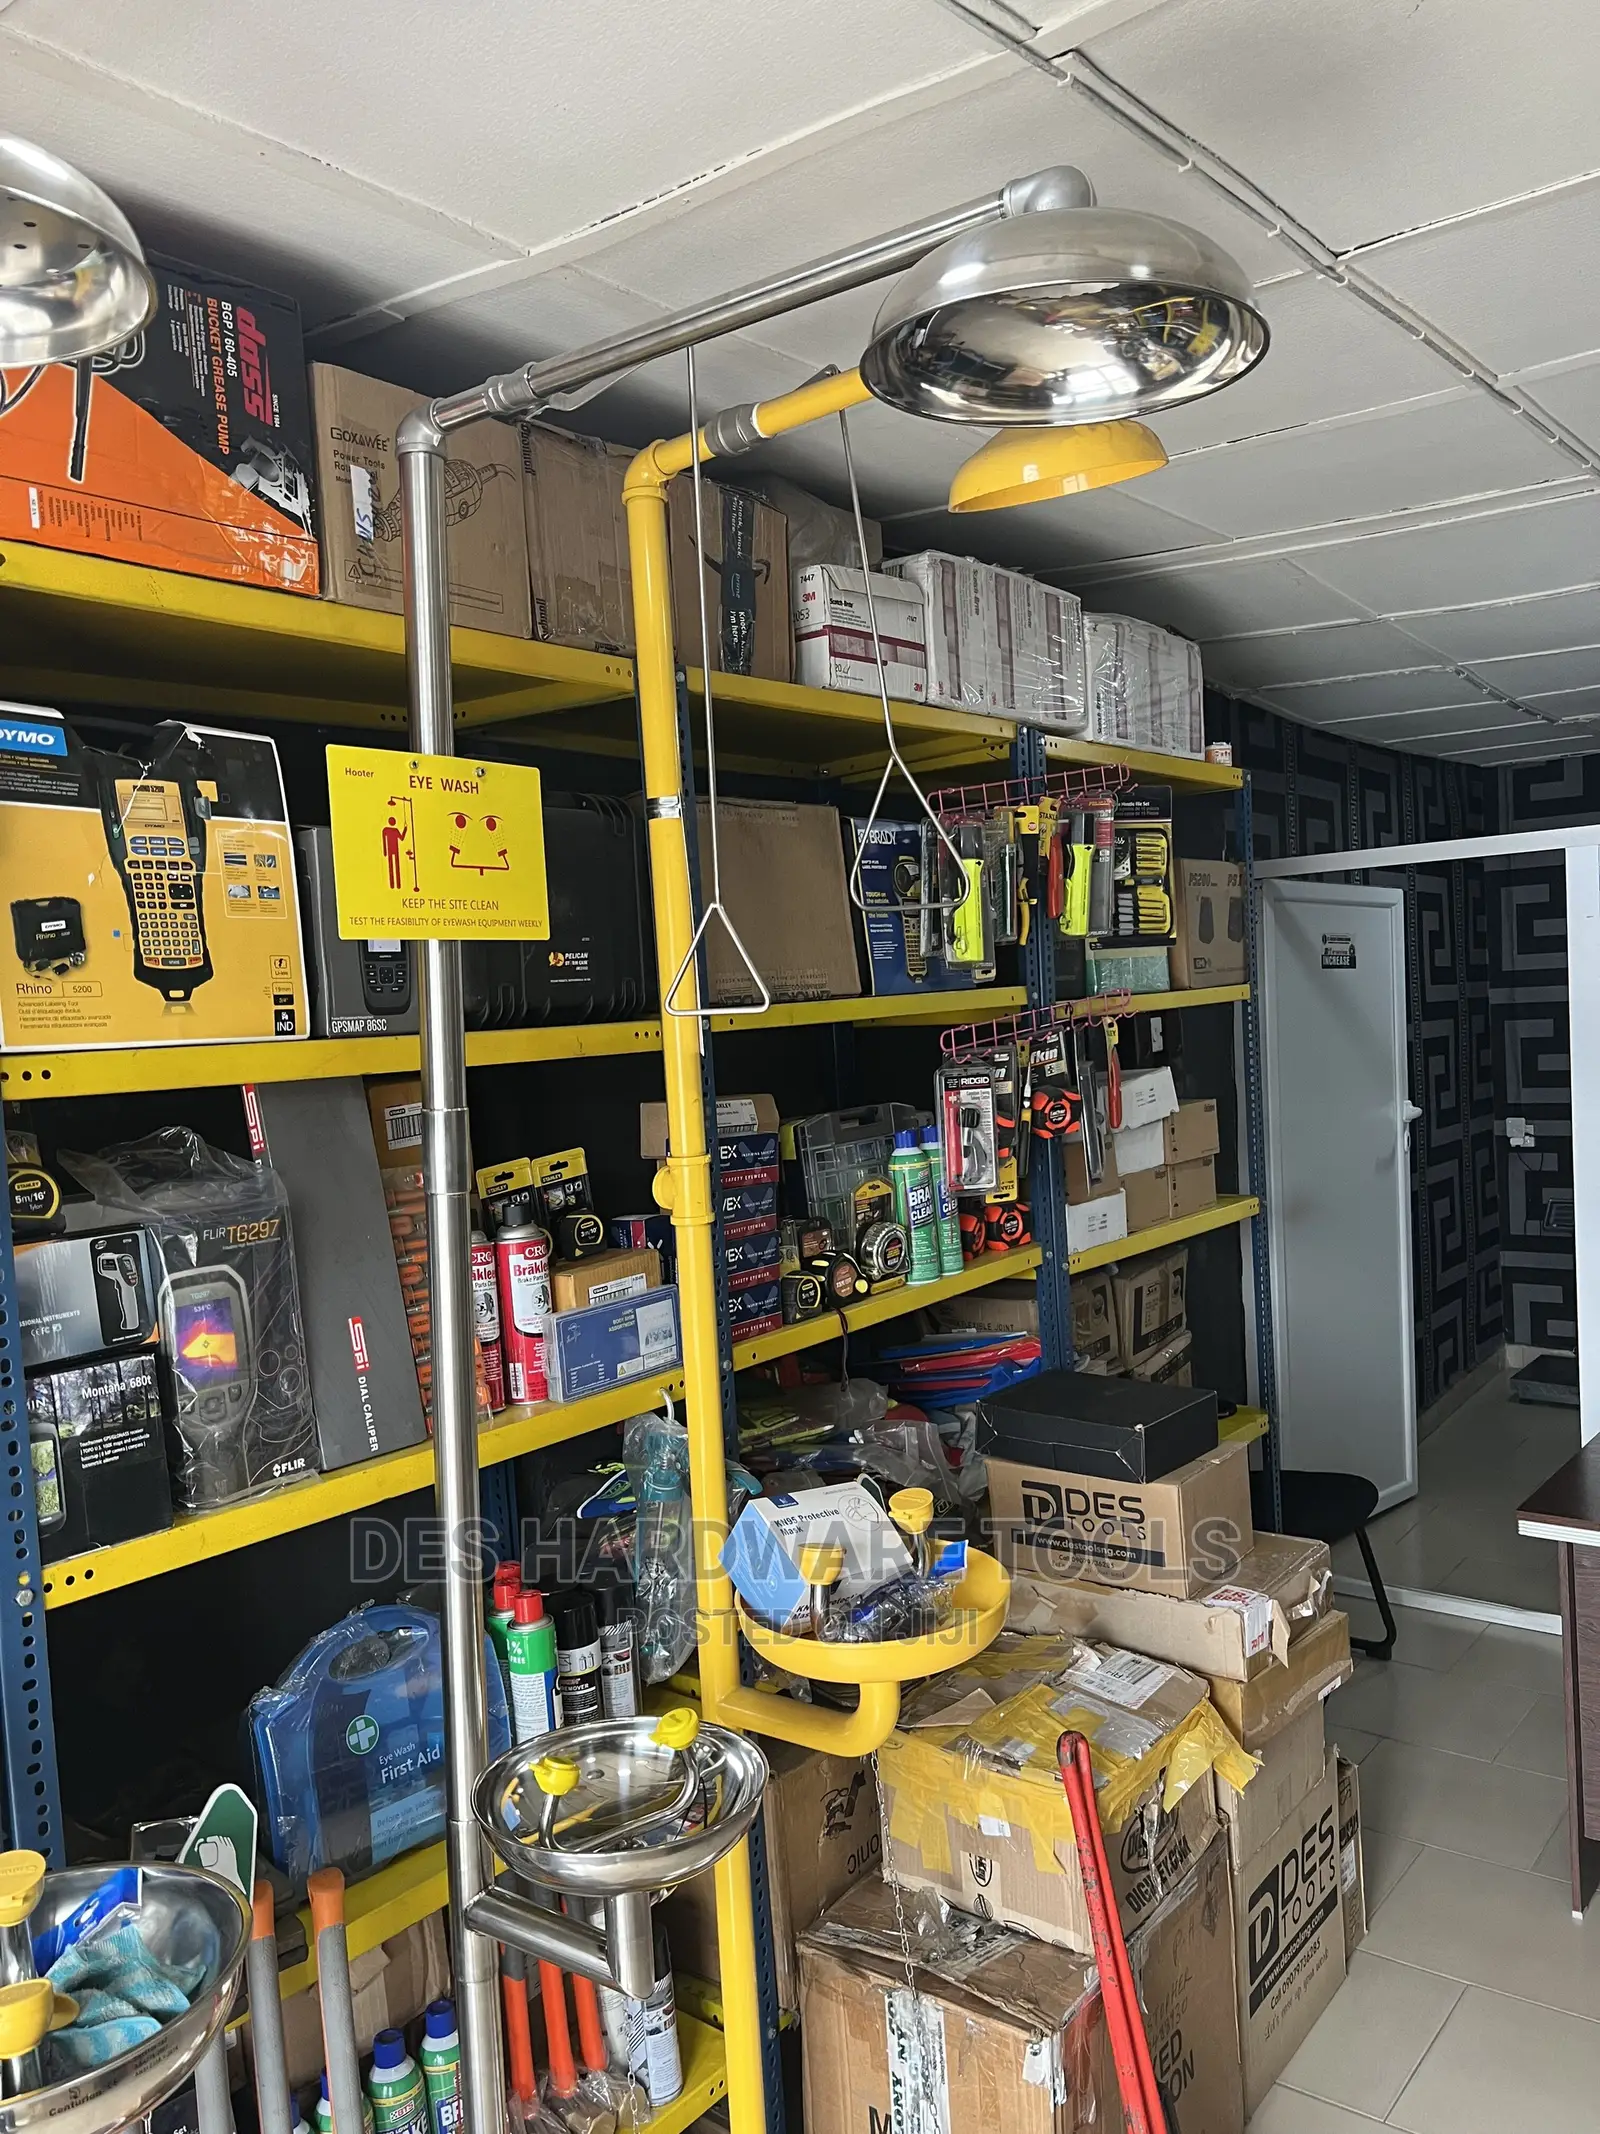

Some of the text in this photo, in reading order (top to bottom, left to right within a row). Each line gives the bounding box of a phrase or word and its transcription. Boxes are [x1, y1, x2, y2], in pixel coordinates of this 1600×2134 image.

[221, 300, 233, 329] BGP
[224, 338, 237, 378] 60-405
[206, 297, 230, 455] BUCKET GREASE PUMP
[330, 427, 388, 452] GOXAWEE
[333, 450, 361, 463] Power
[364, 456, 385, 470] Tools
[800, 574, 815, 584] 7447
[802, 591, 816, 603] 3M
[345, 767, 374, 778] Hooter
[409, 775, 479, 794] EYE WASH
[869, 829, 897, 845] BRADY
[402, 898, 499, 911] KEEP THE SITE CLEAN
[349, 916, 543, 928] TEST THE FEASIBILITY OF EYEWASH EQUIPMENT WEEKLY
[565, 952, 589, 960] PELICAN
[16, 983, 93, 994] Rhino 5200
[277, 1019, 293, 1032] IND
[332, 1018, 388, 1033] GPSMAP 86SC
[961, 1076, 990, 1085] RIDGID
[203, 1219, 279, 1243] FLIR TG297
[525, 1244, 547, 1258] CRC
[518, 1276, 532, 1284] Brake
[190, 1290, 210, 1299] TG297
[43, 1310, 80, 1323] INSTRUMENTS
[82, 1374, 152, 1399] Montana 680t
[357, 1376, 379, 1452] DIAL CALIPER
[280, 1458, 305, 1474] FLIR
[1064, 1487, 1146, 1524] DES
[774, 1506, 840, 1528] KN95 Protective
[779, 1524, 804, 1537] Mask
[1067, 1515, 1147, 1540] TOOLS
[1037, 1535, 1137, 1560] www.destoolsng.com
[379, 1742, 416, 1766] Eye Wash
[381, 1743, 441, 1784] First Aid
[1281, 1804, 1335, 1911] DES
[1280, 1855, 1336, 1940] TOOLS
[396, 2102, 414, 2117] BTS
